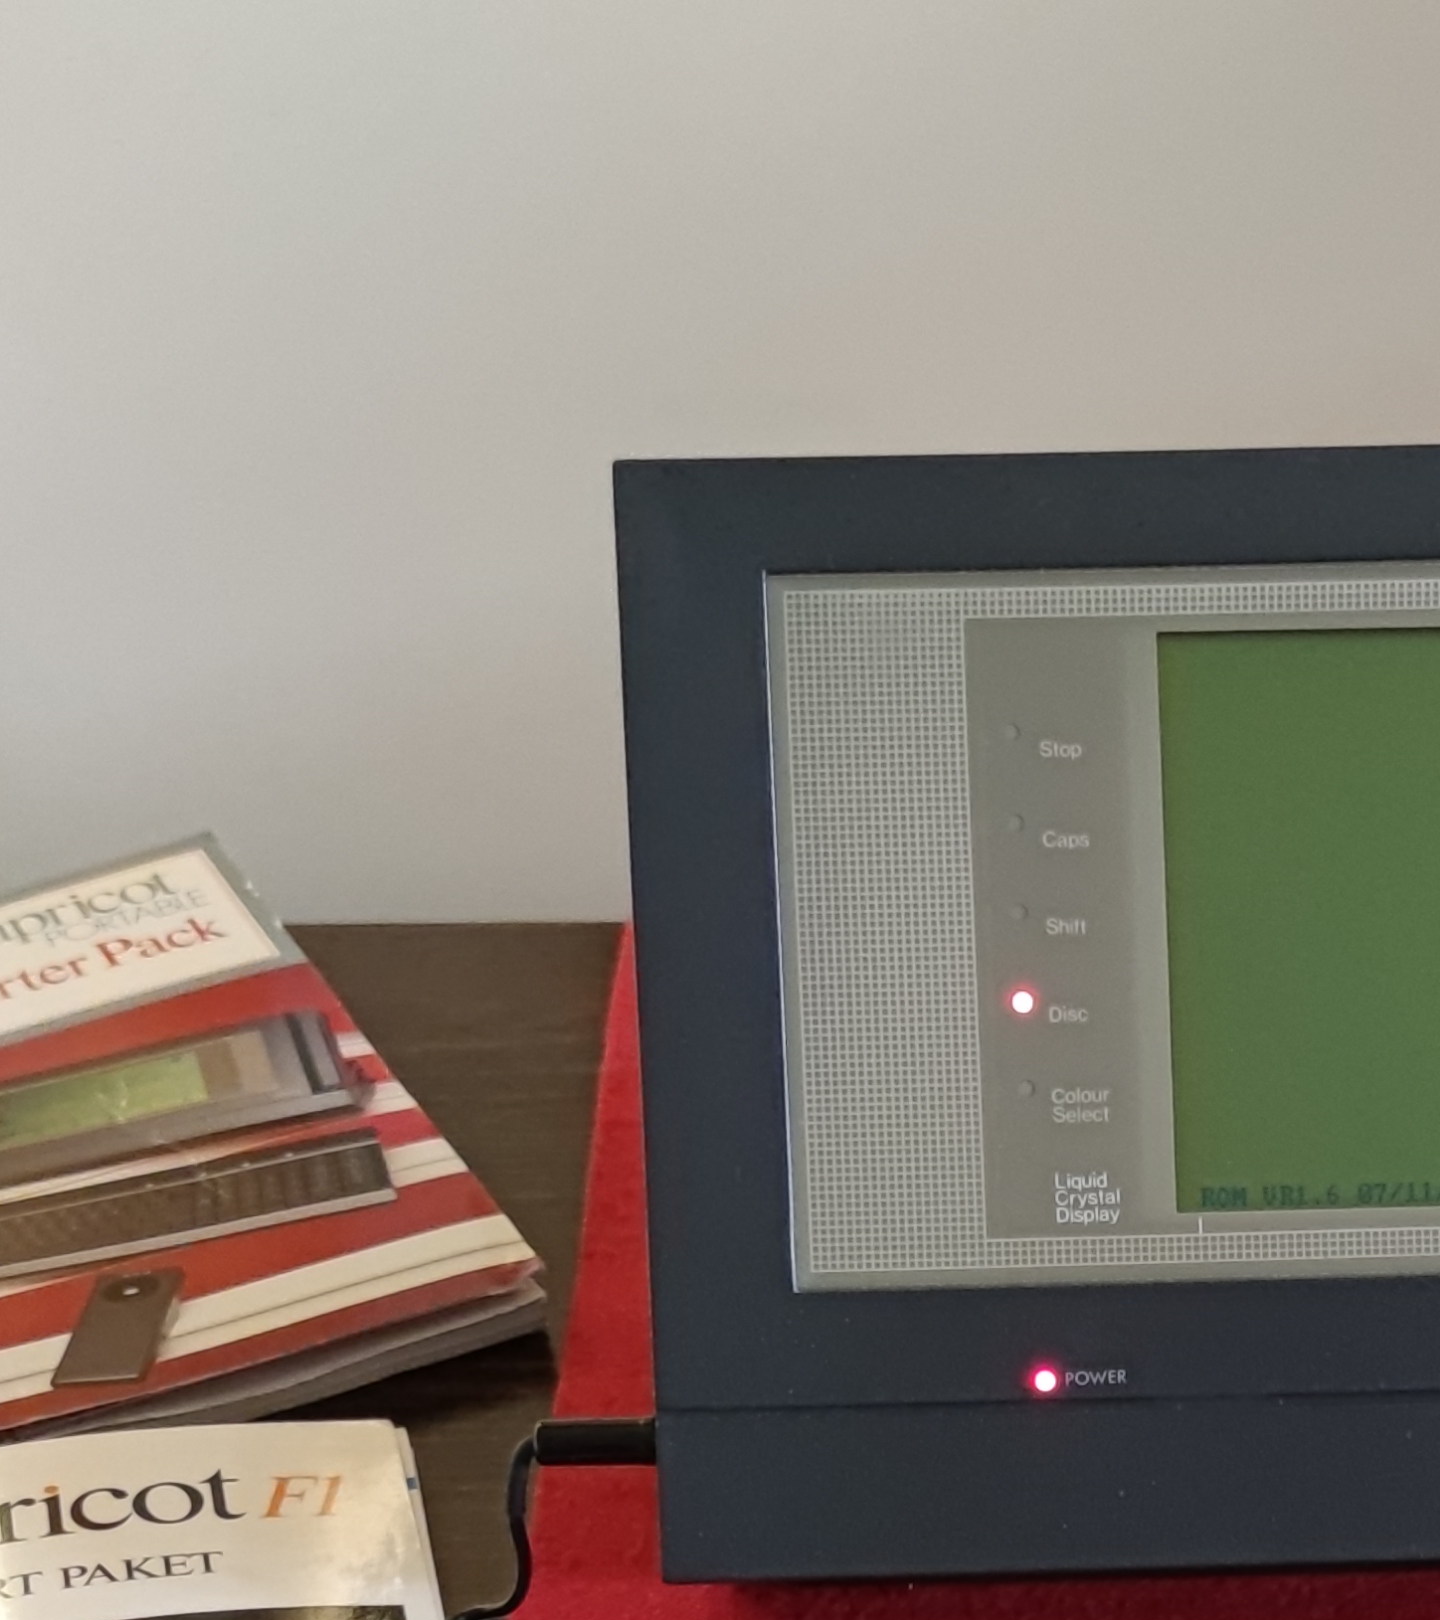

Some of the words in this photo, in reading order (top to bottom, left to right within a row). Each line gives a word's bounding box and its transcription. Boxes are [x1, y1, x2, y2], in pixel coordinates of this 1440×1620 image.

[1039, 740, 1083, 760] Stop
[1041, 830, 1090, 850] Caps
[45, 888, 210, 948] PORTABLE
[1046, 917, 1087, 935] Shift
[96, 917, 227, 968] Pack
[1047, 1004, 1087, 1023] Disc
[1050, 1087, 1110, 1105] Colour
[1052, 1105, 1110, 1123] Select
[1054, 1171, 1108, 1192] Liquid
[1054, 1187, 1121, 1208] Crystal
[1200, 1186, 1248, 1208] ROM
[1055, 1205, 1120, 1225] Display
[1062, 1369, 1126, 1390] POWER
[261, 1473, 344, 1519] F1
[58, 1549, 224, 1593] PAKET
